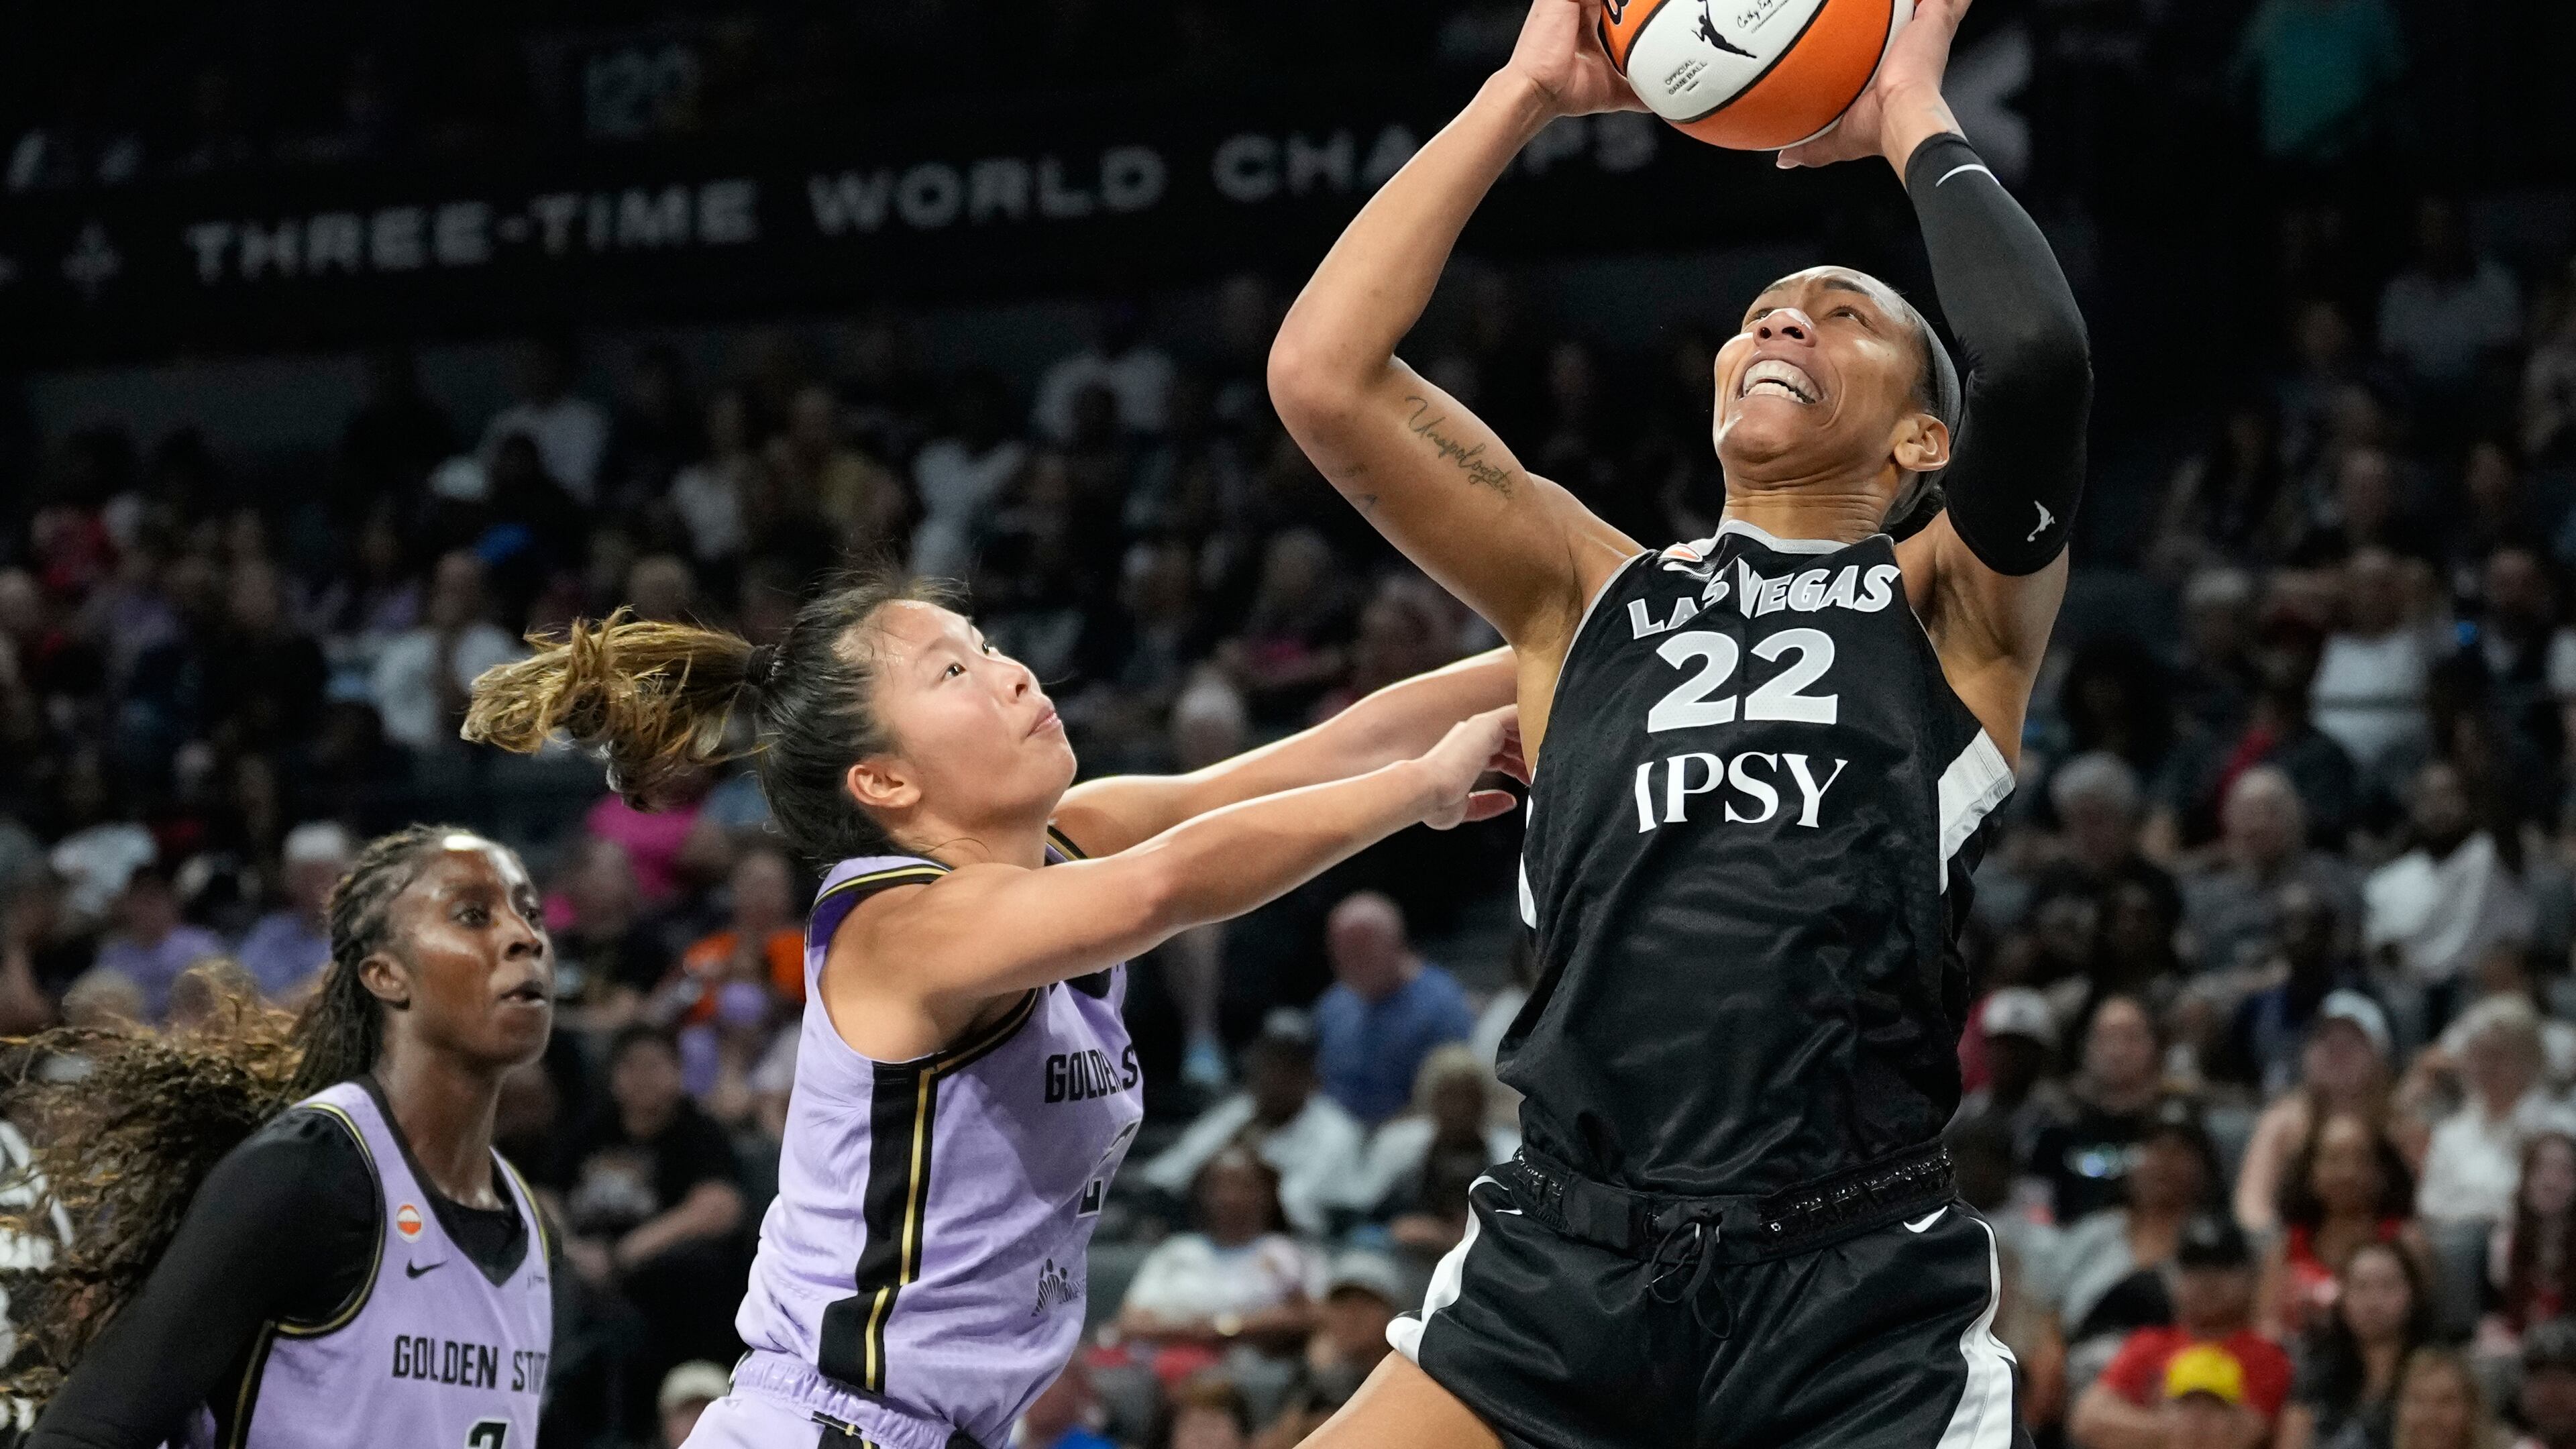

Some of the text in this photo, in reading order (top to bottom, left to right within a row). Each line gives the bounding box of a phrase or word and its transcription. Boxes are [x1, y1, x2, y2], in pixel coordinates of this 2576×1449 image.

[1665, 60, 1696, 85] OFFICIAL
[1668, 78, 1688, 95] GAME
[1686, 62, 1707, 79] BALL
[186, 113, 1660, 282] THREE-TIME WORLD CHAPS
[1627, 556, 1901, 639] LAS VEGAS
[1647, 627, 1838, 733] 22
[1635, 751, 1849, 833] IPSY
[392, 1335, 498, 1389] GOLDEN
